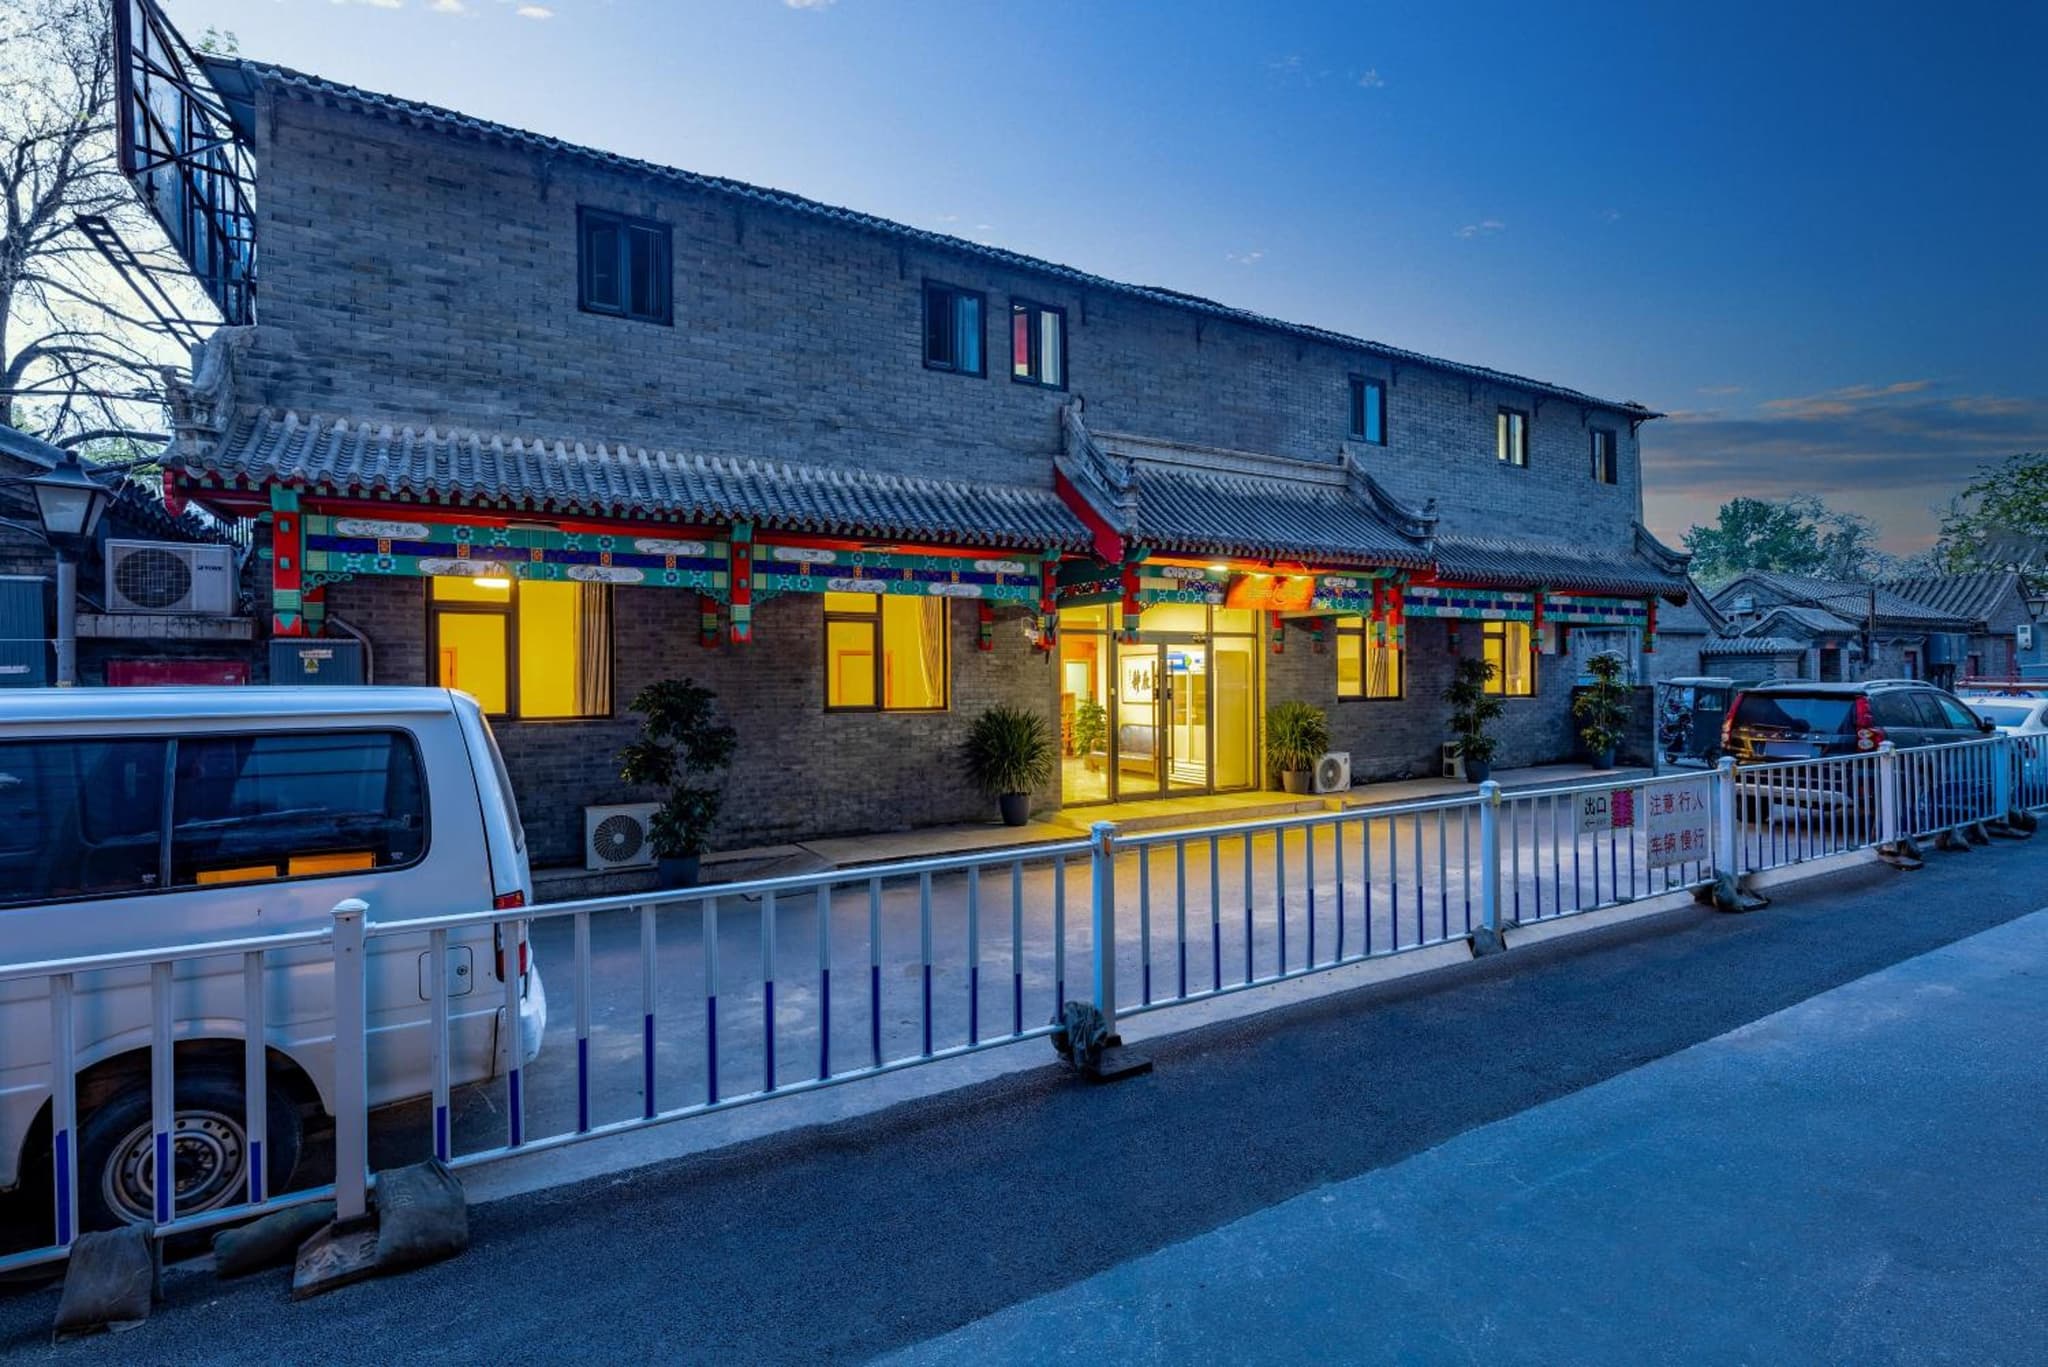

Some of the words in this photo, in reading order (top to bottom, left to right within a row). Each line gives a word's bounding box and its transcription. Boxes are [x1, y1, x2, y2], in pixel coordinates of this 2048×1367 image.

[1584, 797, 1606, 816] 出口
[1650, 791, 1704, 816] 注意行人
[1650, 828, 1704, 856] 车辆慢行
